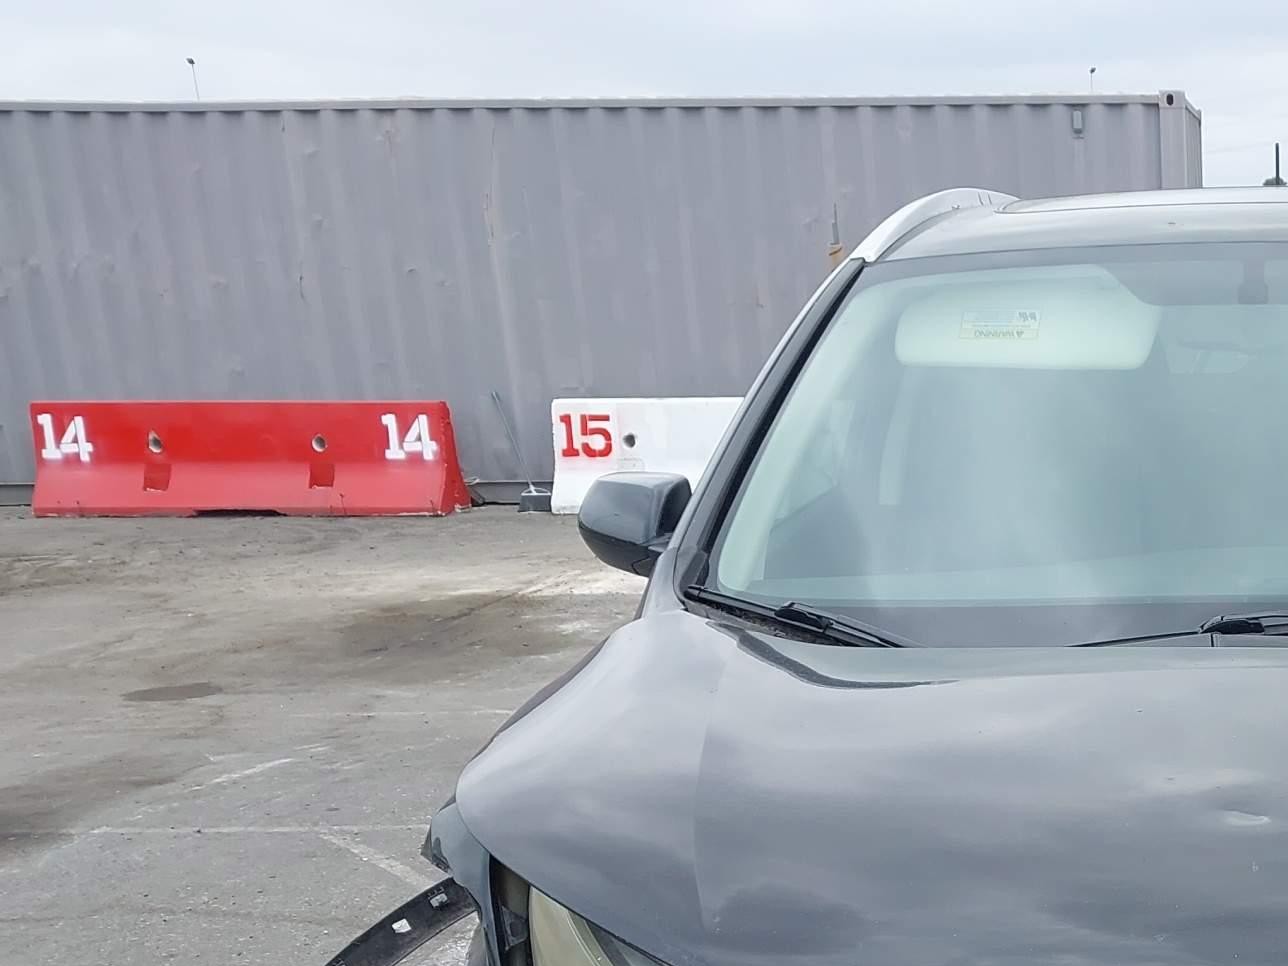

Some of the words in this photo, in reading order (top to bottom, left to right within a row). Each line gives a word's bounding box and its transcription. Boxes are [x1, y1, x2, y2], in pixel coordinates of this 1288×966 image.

[38, 413, 93, 461] 14
[381, 413, 438, 461] 14
[559, 414, 613, 458] 15
